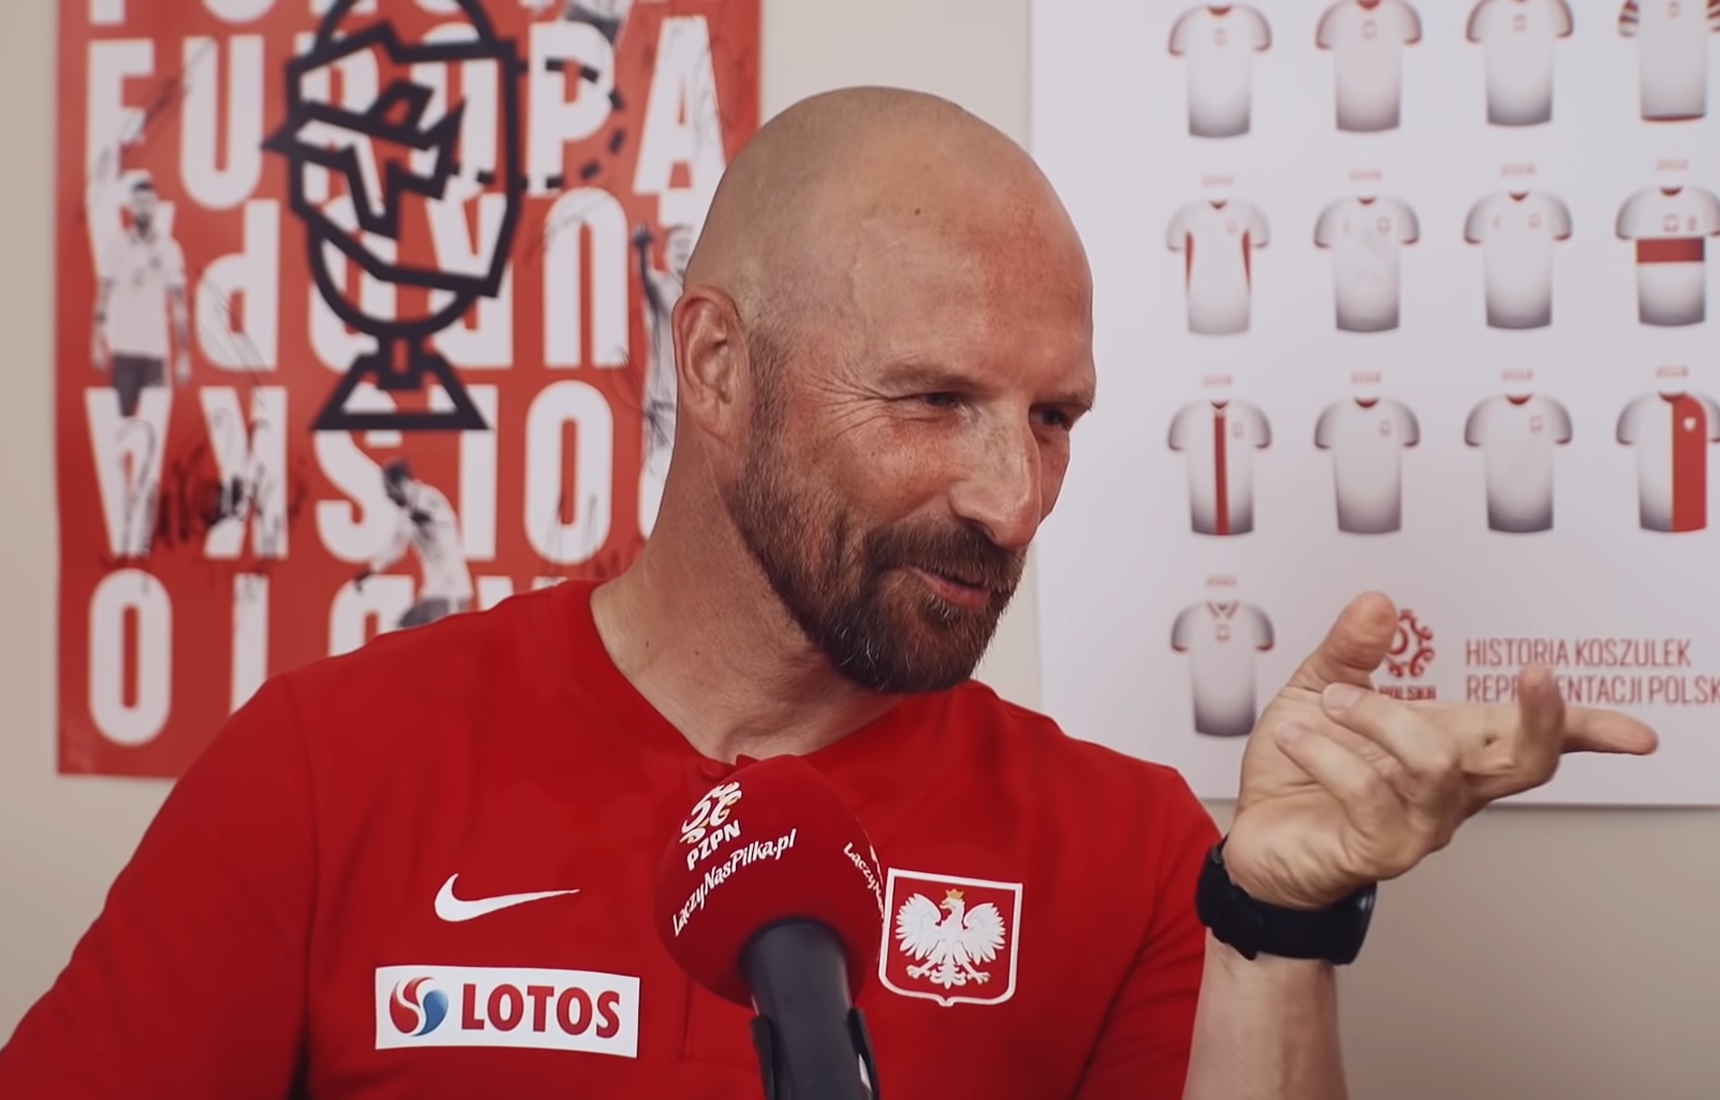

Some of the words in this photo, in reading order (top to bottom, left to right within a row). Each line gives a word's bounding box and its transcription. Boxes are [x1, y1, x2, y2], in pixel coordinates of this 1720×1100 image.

[1466, 638, 1570, 667] HISTORIA
[1575, 638, 1692, 667] KOSZULEK
[1466, 674, 1643, 704] REPRNTACJI
[686, 820, 741, 871] PZPN
[461, 983, 620, 1039] LOTOS
